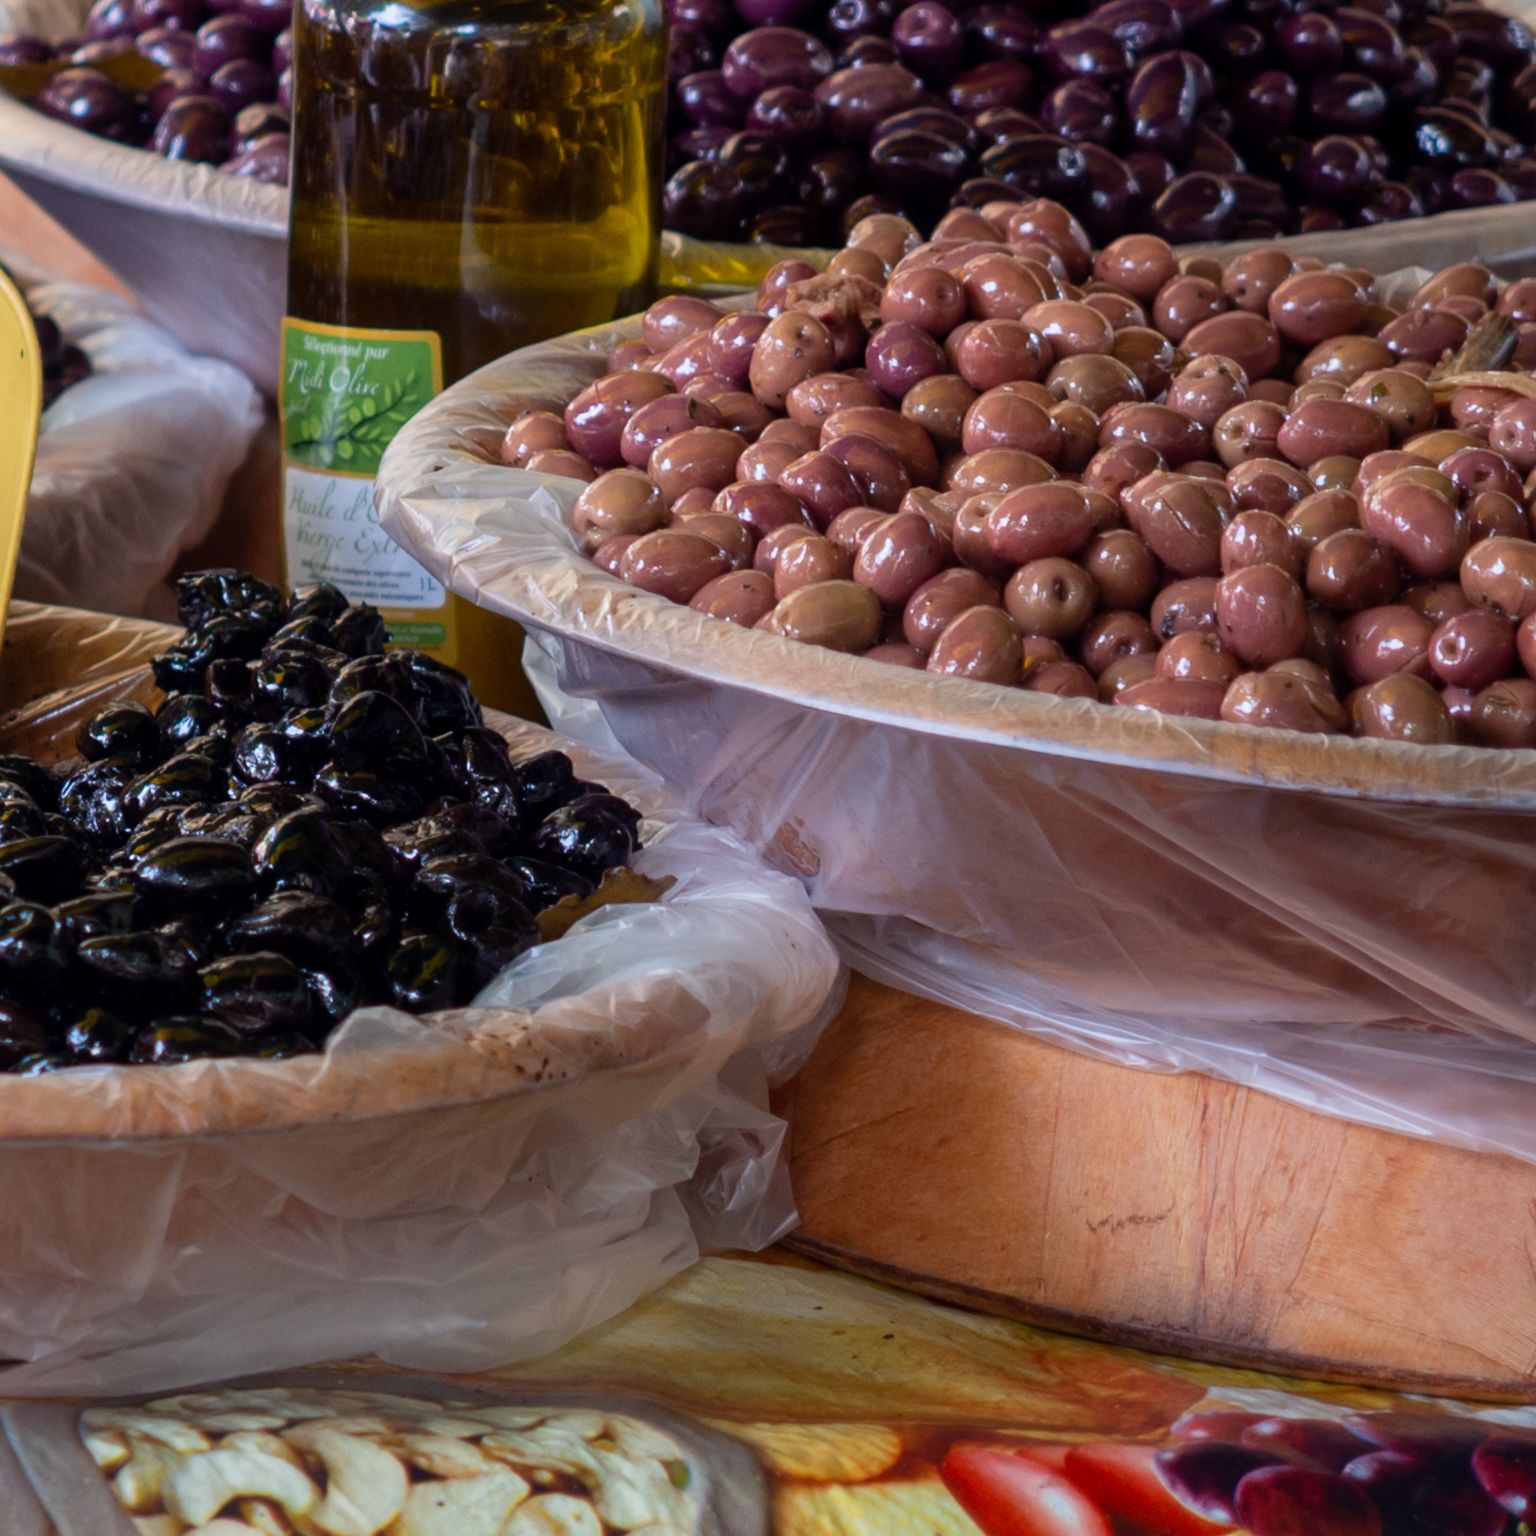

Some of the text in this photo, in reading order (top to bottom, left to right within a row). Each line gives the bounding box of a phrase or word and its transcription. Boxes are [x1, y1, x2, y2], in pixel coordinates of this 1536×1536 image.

[364, 346, 390, 362] par
[330, 361, 380, 396] Olive
[289, 478, 336, 519] Huile
[295, 516, 345, 565] Vierge
